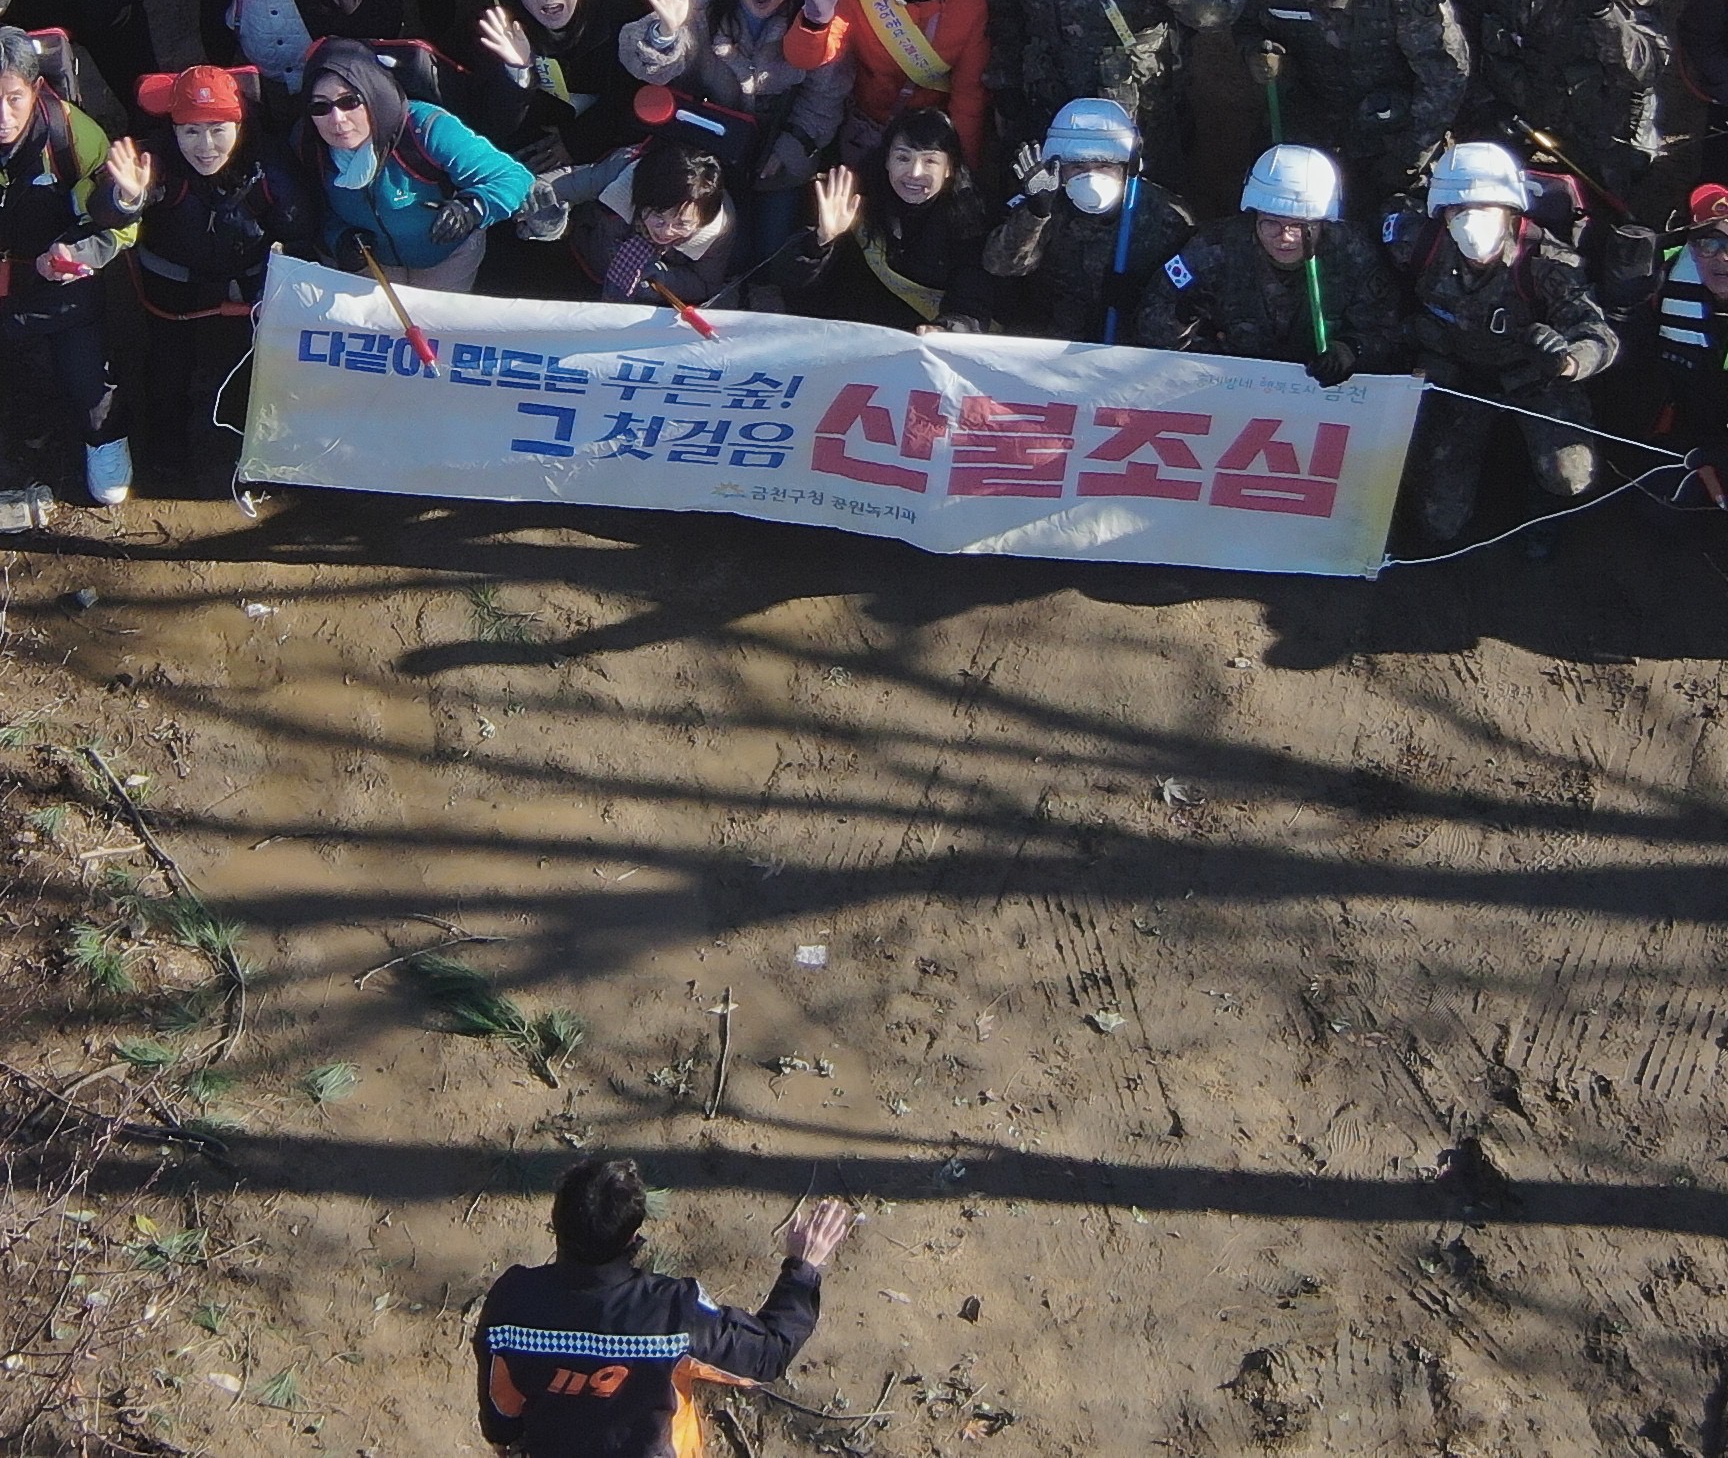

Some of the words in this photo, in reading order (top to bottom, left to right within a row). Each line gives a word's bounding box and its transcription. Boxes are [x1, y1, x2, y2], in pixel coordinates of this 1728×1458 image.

[298, 329, 441, 379] 다같이
[449, 342, 589, 395] 만드는
[601, 353, 724, 408] 푸른
[721, 371, 804, 410] 숲!
[511, 401, 577, 458] 그
[591, 411, 795, 470] 첫걸음
[811, 383, 1350, 519] 산불조심
[751, 485, 825, 507] 금천구청
[831, 495, 918, 525] 공원녹지과
[547, 1365, 629, 1398] 119
